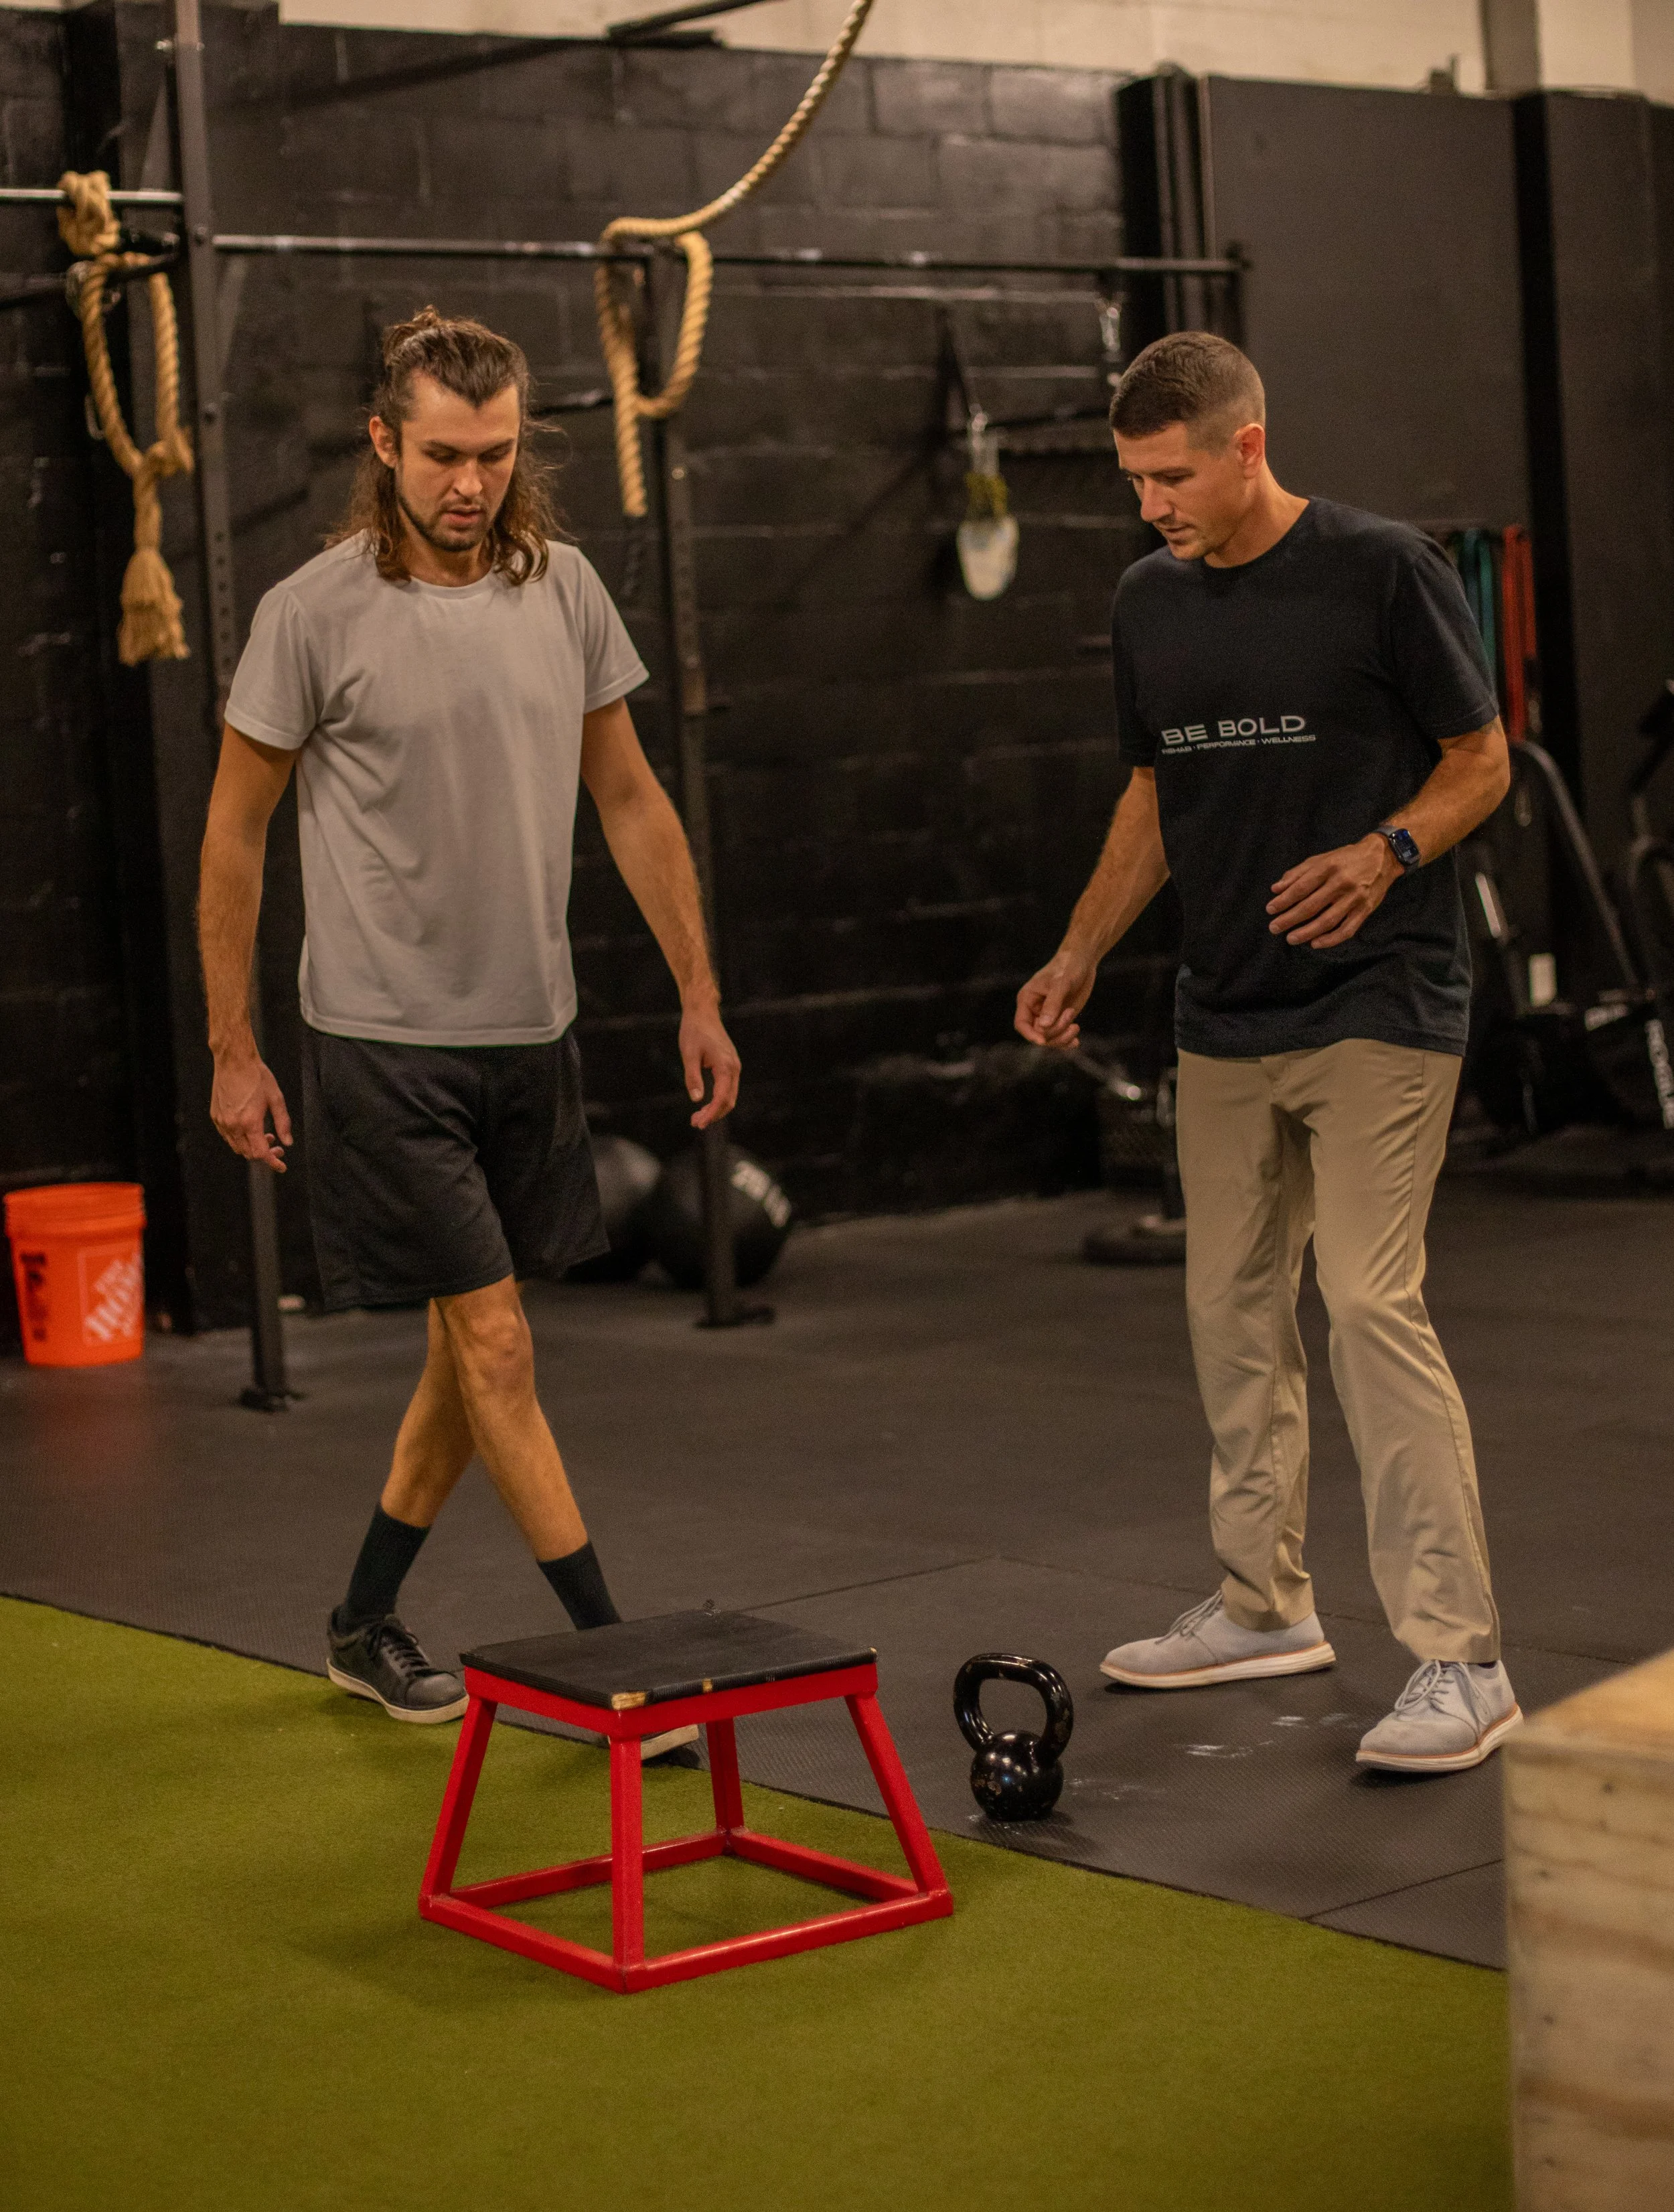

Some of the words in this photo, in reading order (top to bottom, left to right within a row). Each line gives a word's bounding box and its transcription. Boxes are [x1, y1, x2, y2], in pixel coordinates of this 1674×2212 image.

[1161, 724, 1208, 745] BE
[1217, 715, 1305, 737] BOLD
[1197, 739, 1256, 749] PERFORMANCE
[1262, 735, 1316, 745] WELLNESS
